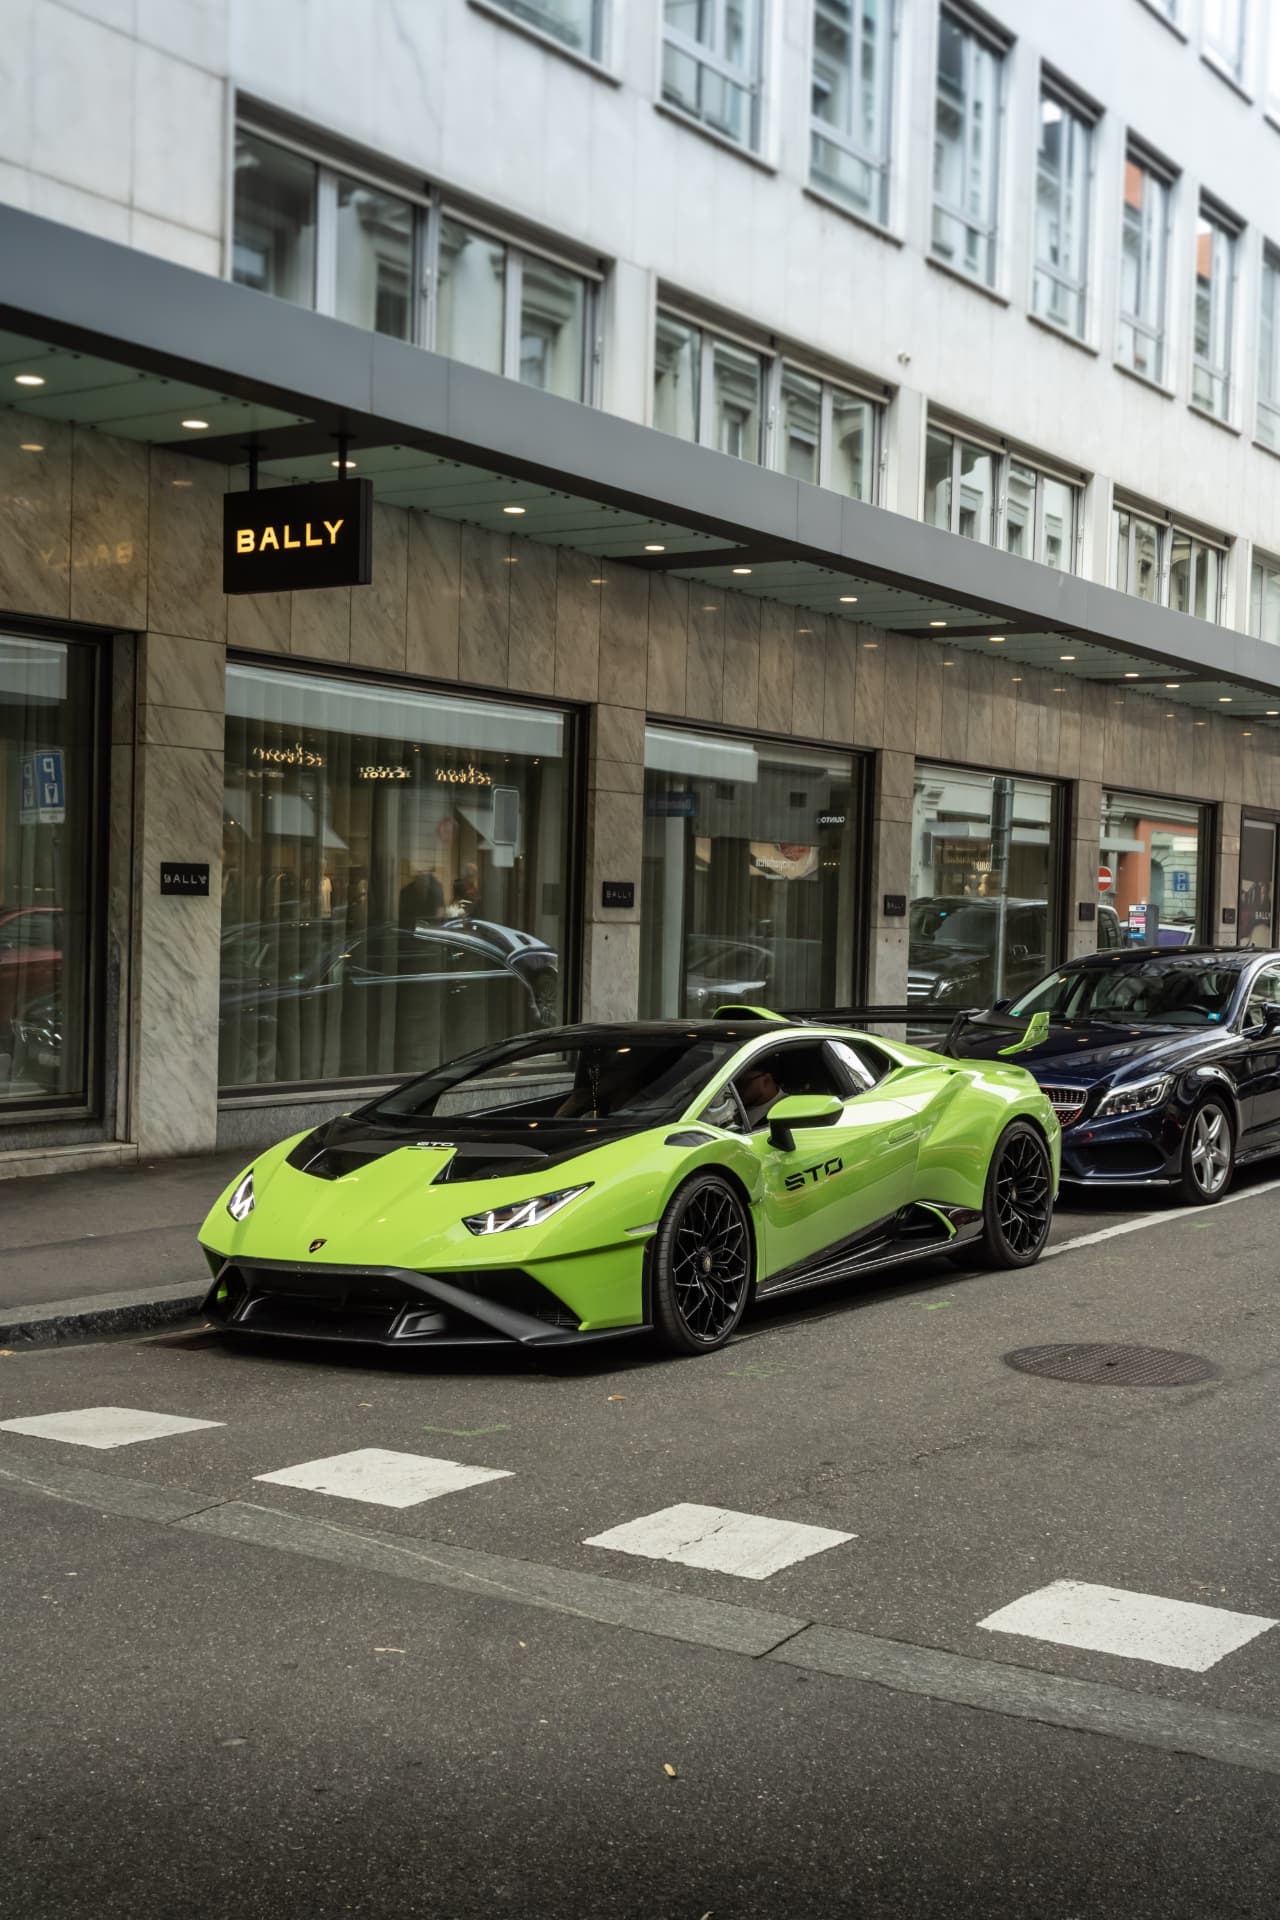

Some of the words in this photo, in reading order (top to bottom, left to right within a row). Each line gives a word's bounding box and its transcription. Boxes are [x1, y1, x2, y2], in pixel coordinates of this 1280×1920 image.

[236, 519, 344, 553] BALLY
[163, 873, 207, 884] BALLY
[784, 1157, 843, 1191] STO
